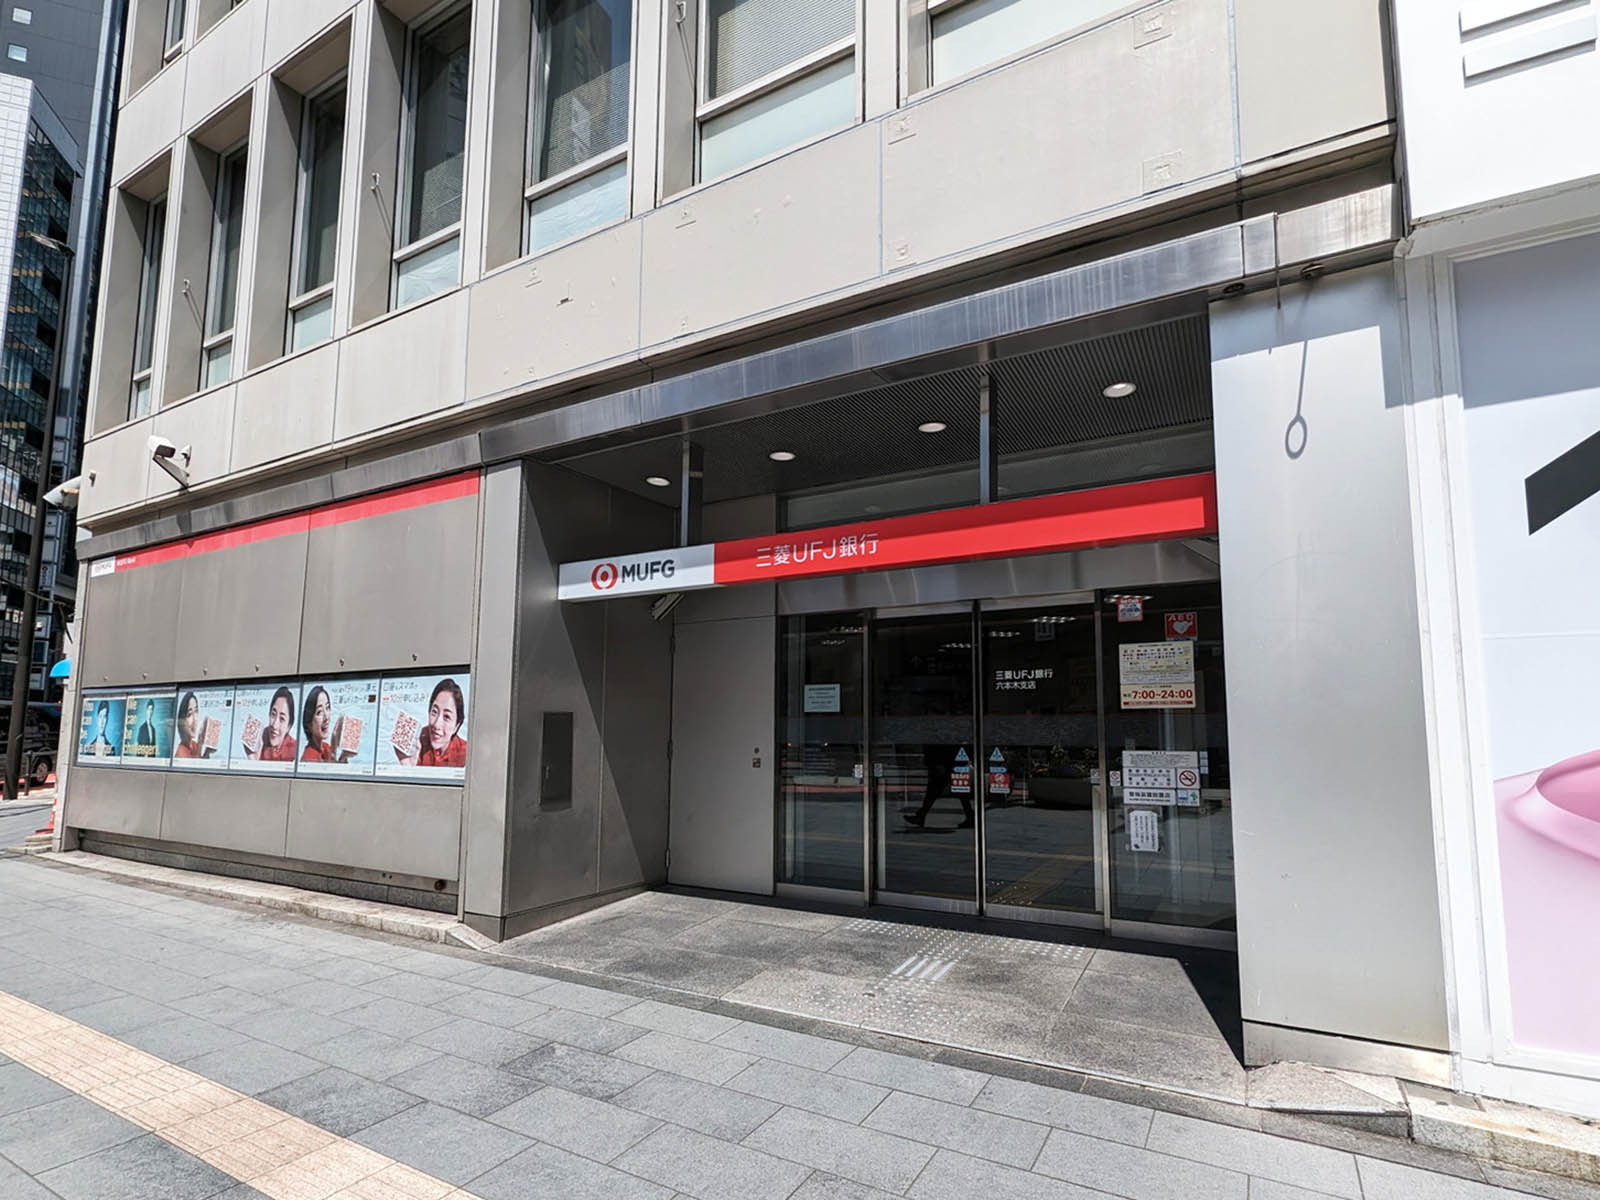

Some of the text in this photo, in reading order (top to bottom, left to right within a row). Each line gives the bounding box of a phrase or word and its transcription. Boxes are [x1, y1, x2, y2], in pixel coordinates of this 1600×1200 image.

[755, 533, 880, 568] 三菱UFJ銀行
[621, 559, 675, 583] MUFG
[1167, 613, 1194, 621] AED
[995, 669, 1053, 680] 三菱UFJ銀行
[995, 681, 1036, 690] 六本木支店
